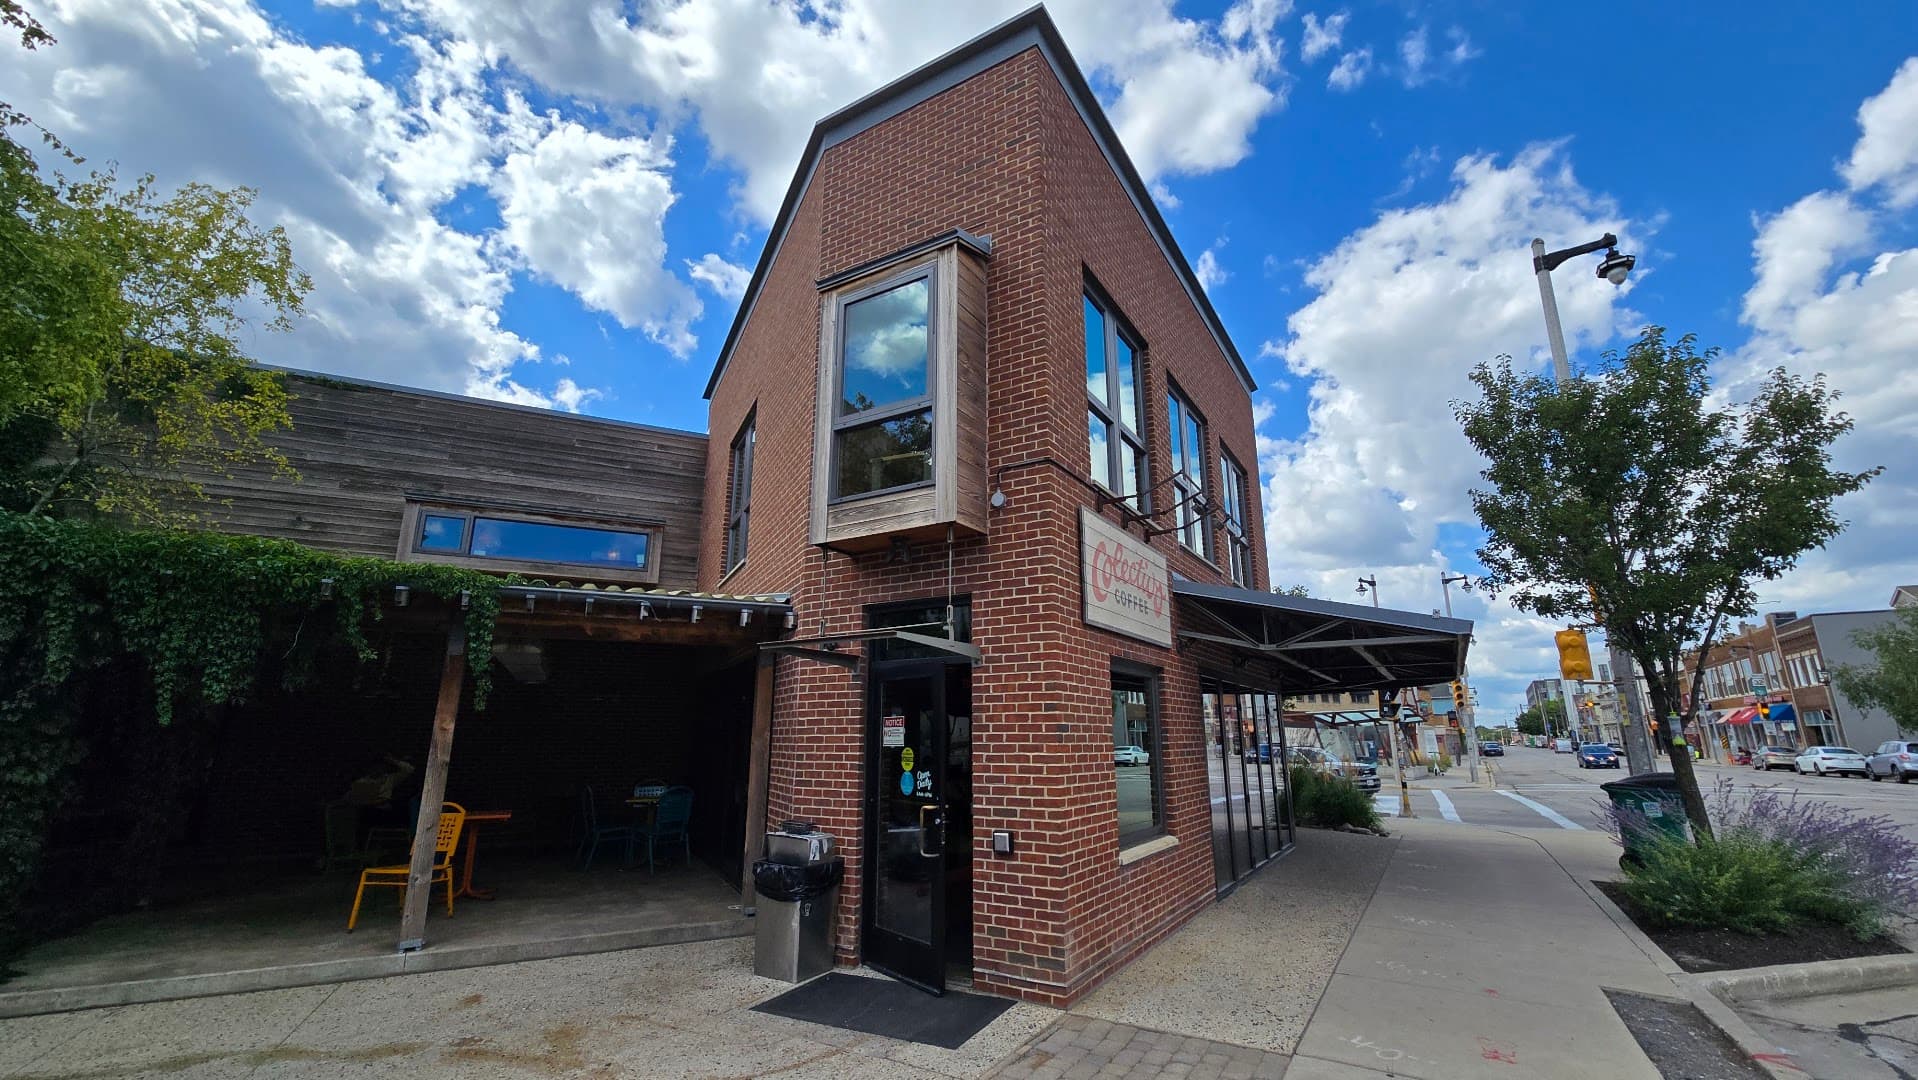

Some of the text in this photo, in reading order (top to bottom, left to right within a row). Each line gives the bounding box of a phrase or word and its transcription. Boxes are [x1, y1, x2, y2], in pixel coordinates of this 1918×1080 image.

[1092, 541, 1167, 618] Colectivo
[1114, 588, 1149, 615] COFFEE
[885, 718, 903, 726] NOTICE
[917, 771, 931, 781] Open
[917, 777, 932, 790] Daily
